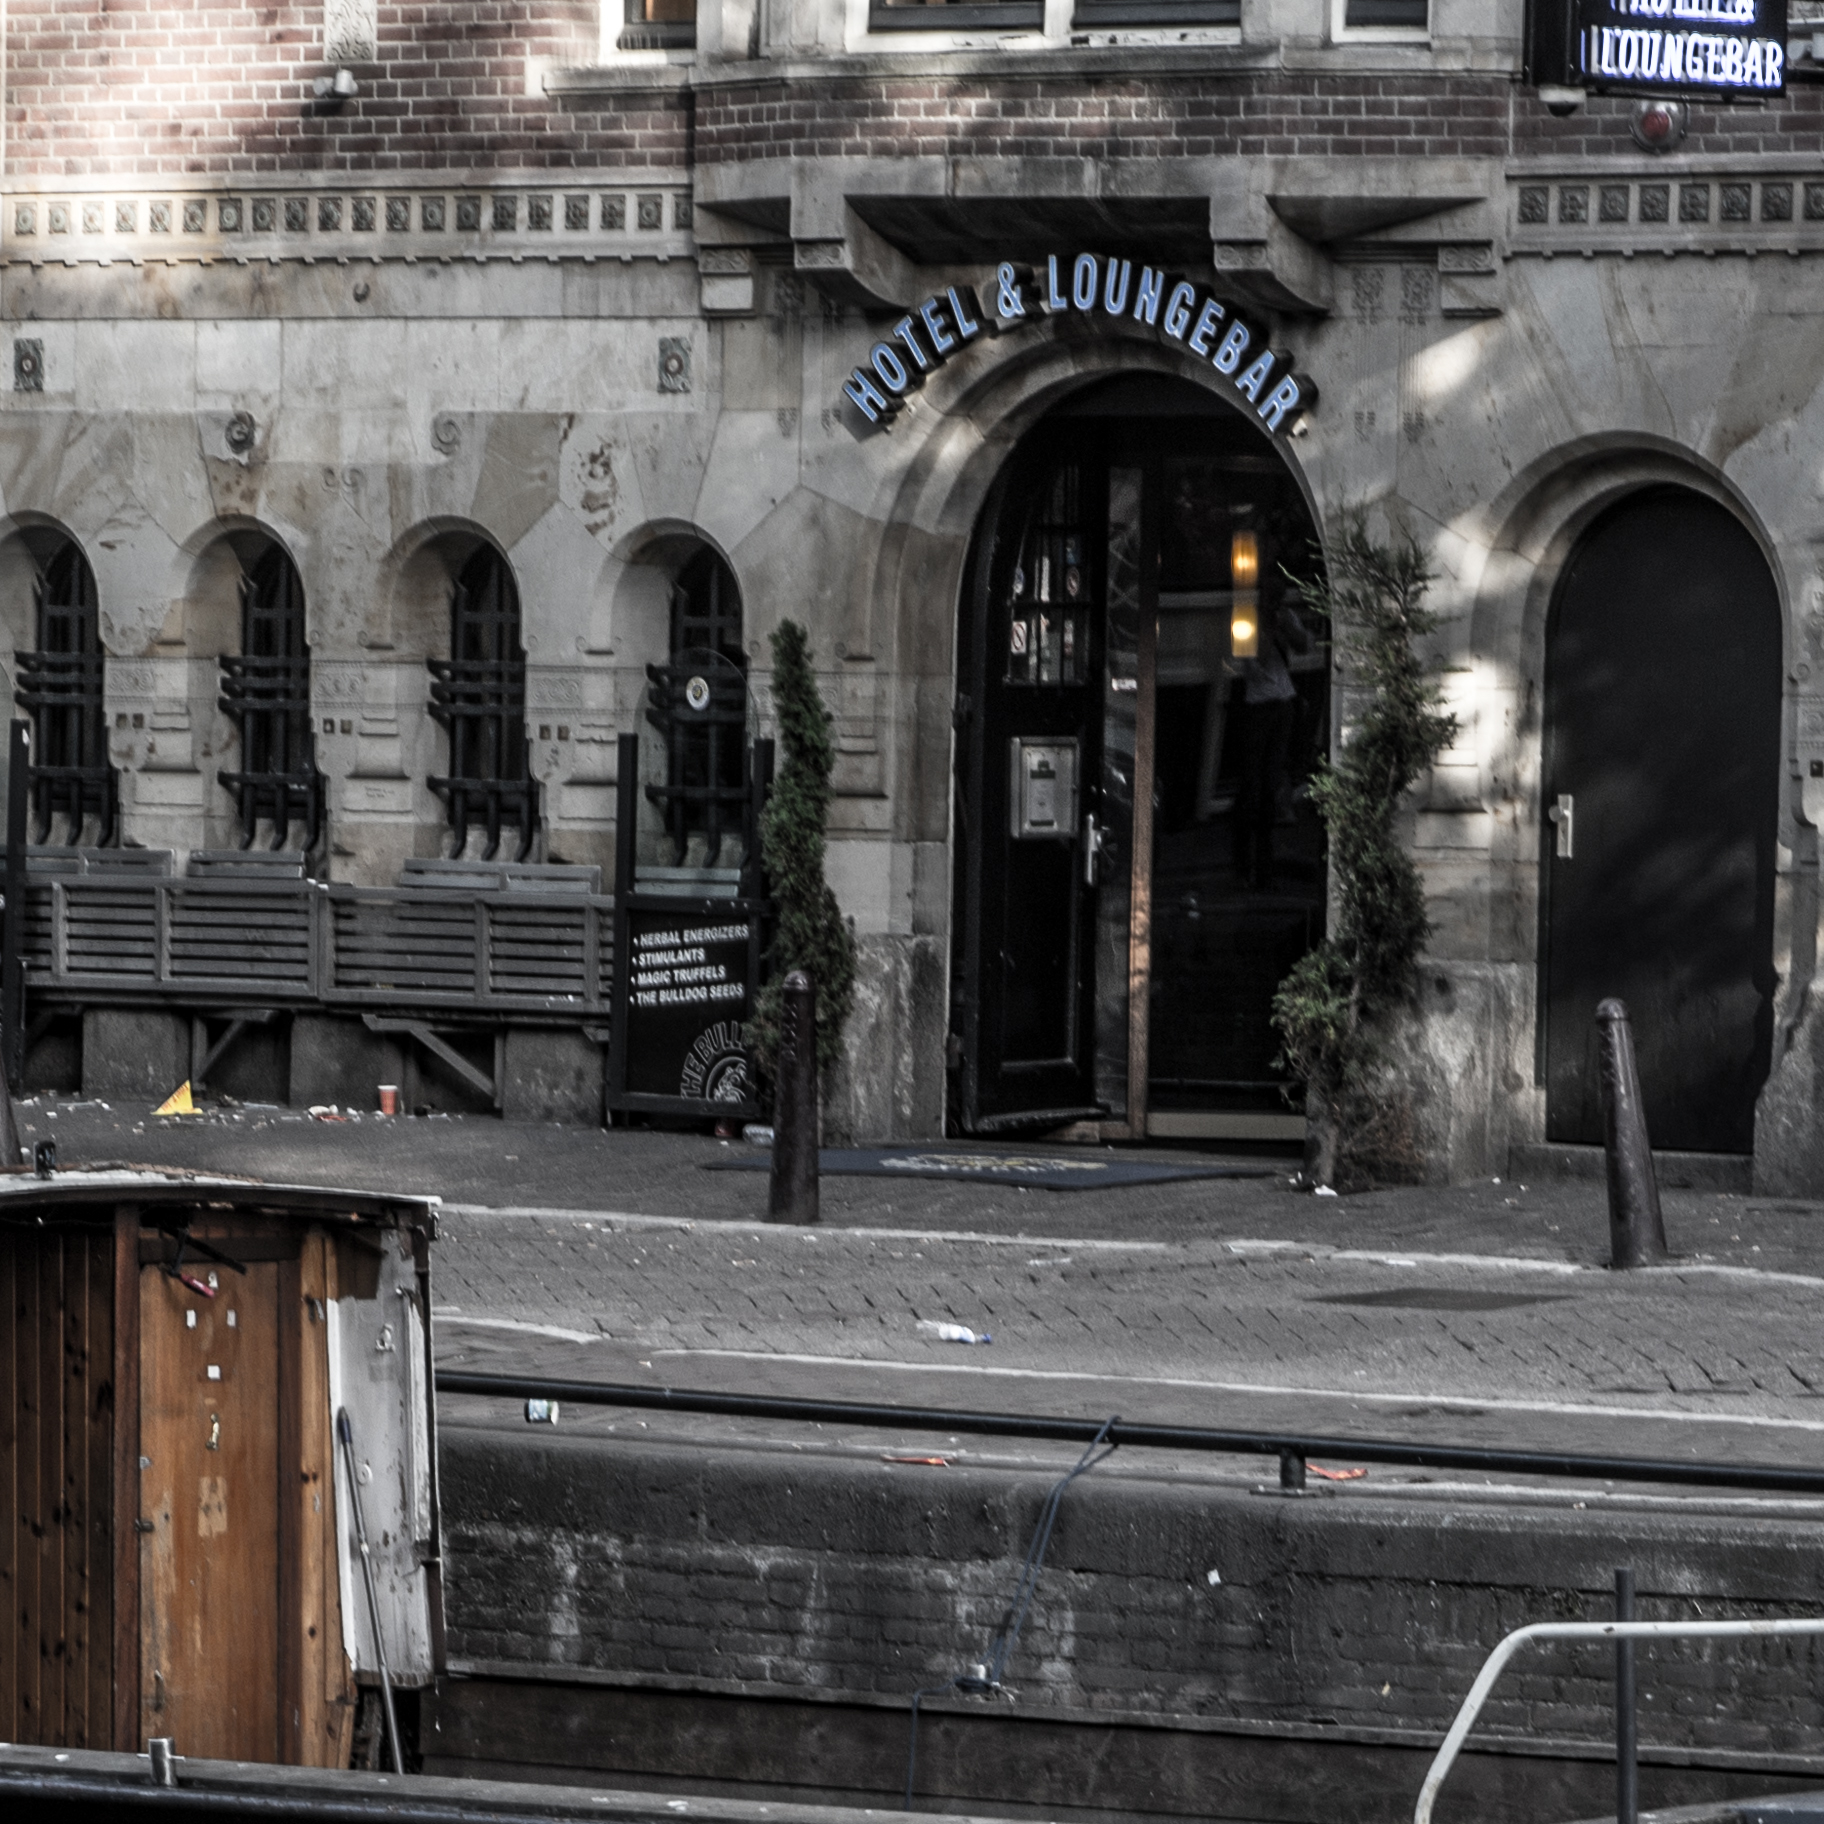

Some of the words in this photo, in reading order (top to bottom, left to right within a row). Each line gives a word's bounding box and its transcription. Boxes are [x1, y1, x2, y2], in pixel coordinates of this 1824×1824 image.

[1594, 27, 1784, 88] LOUNGEBAR
[842, 286, 979, 423] HOTEL
[996, 261, 1026, 318] &
[1047, 252, 1301, 434] LOUNGEBAR
[640, 930, 681, 948] HERBAL
[683, 924, 749, 943] ENERGIZERS
[638, 948, 705, 967] STIMULANTS
[637, 969, 672, 988] MAGIC
[673, 965, 726, 983] TRUFFELS
[636, 989, 658, 1008] THE
[659, 985, 708, 1006] BULLDOG
[709, 983, 744, 999] SEEDS
